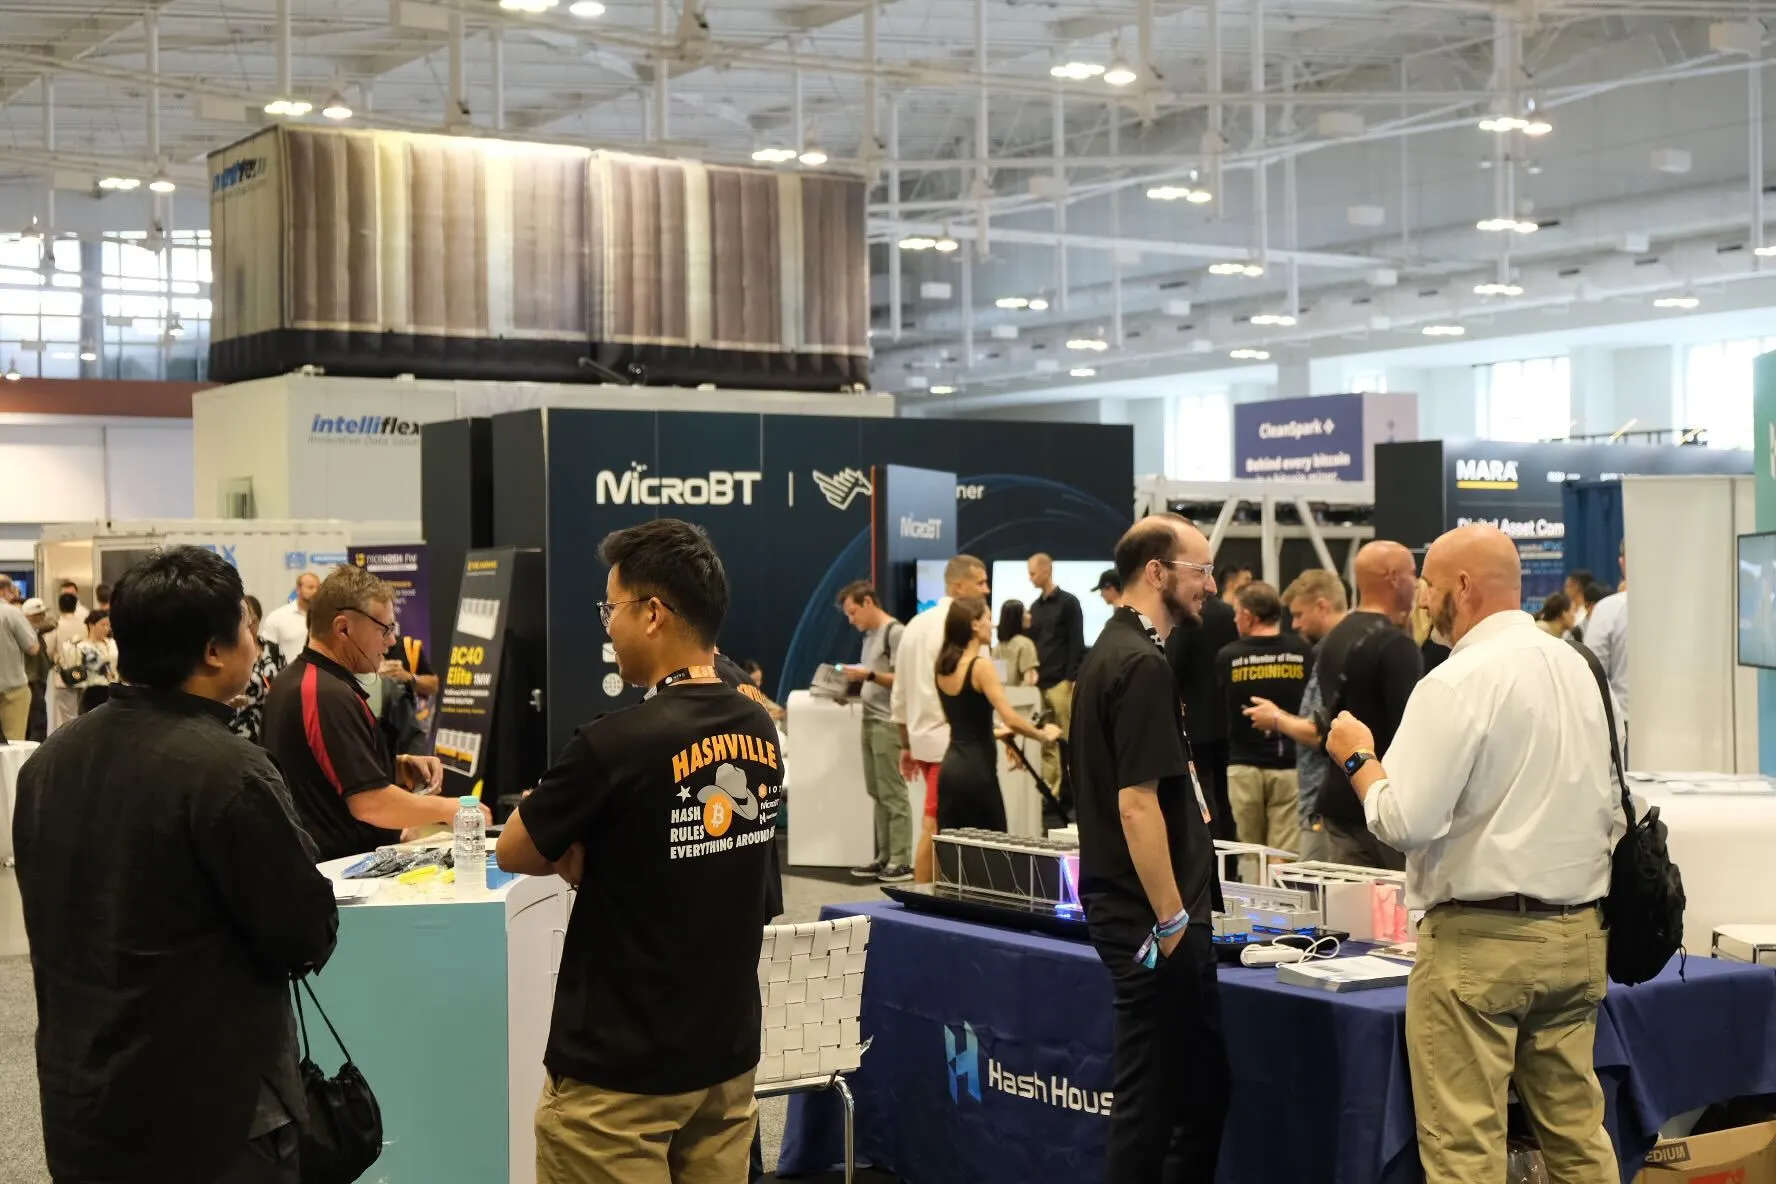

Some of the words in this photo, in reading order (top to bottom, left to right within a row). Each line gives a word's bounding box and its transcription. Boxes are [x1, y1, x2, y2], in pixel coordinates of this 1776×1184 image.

[312, 413, 419, 435] intelliflex
[1258, 418, 1323, 440] CleanSpark
[1245, 456, 1282, 473] Behind
[1283, 456, 1312, 472] every
[1312, 451, 1351, 468] bitcoin
[1456, 459, 1518, 481] MARA
[450, 646, 484, 665] BC40
[447, 667, 472, 685] Elite
[1232, 664, 1304, 683] BITCOINICUS
[672, 734, 778, 783] HASHVILLE
[671, 806, 701, 823] HASH
[670, 824, 705, 842] RULES
[670, 837, 734, 859] EVERYTHING
[988, 1058, 1048, 1103] Hash
